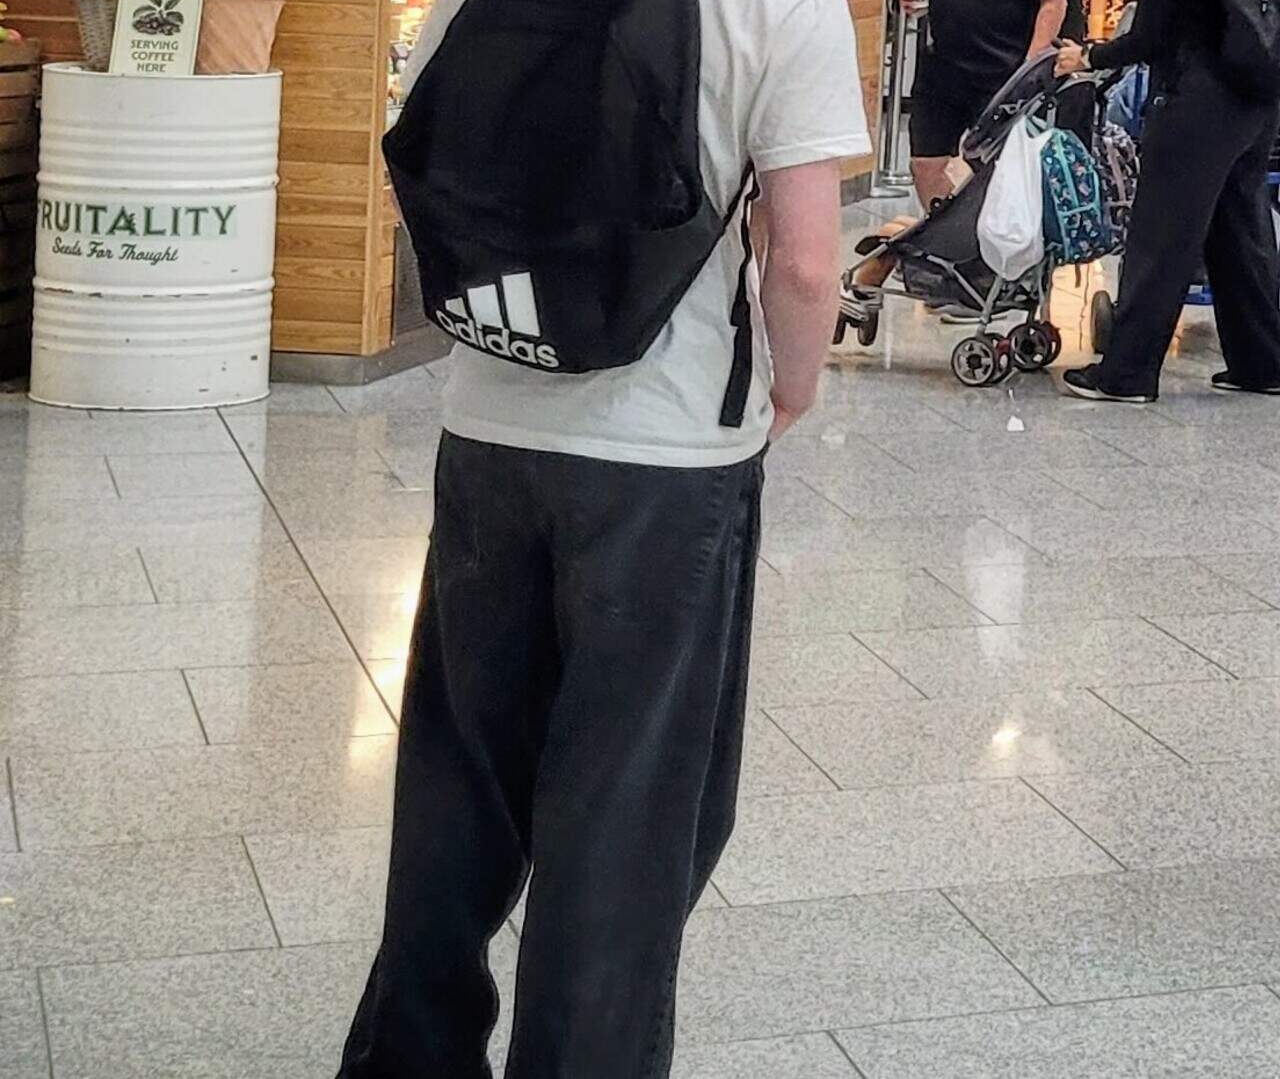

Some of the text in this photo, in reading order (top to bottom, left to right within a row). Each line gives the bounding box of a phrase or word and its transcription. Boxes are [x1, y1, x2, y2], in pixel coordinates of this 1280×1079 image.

[130, 39, 179, 51] SERVING
[131, 51, 175, 62] COFFEE
[137, 62, 167, 72] HERE
[52, 237, 179, 266] Seeds For Thought
[436, 310, 560, 368] adidas
